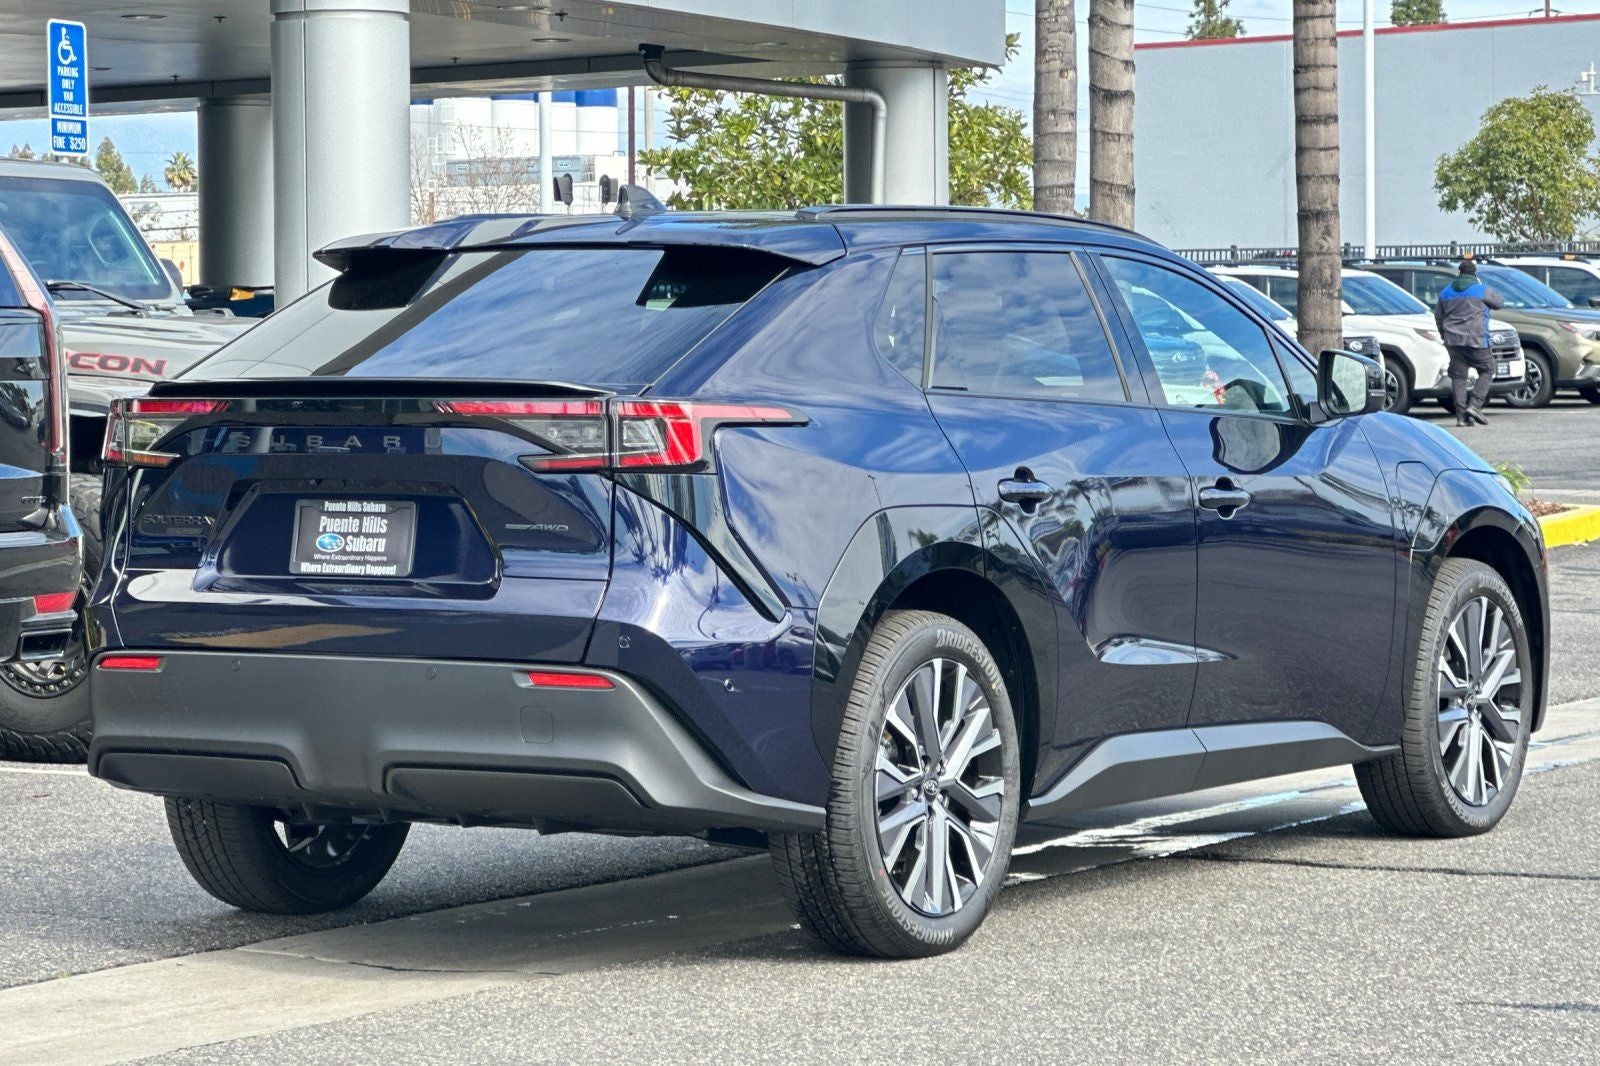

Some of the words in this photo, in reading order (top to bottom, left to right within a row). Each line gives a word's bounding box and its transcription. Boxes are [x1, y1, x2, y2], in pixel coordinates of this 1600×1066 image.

[57, 65, 79, 78] PARKING
[61, 79, 75, 90] ONLY
[63, 91, 74, 102] VAN
[53, 102, 84, 115] ACCESSIBLE
[56, 121, 82, 134] MINIMUM
[53, 137, 66, 149] FINE
[69, 136, 86, 151] $250
[236, 433, 443, 449] SUBARU
[324, 501, 347, 512] Puente
[347, 501, 362, 512] Hills
[362, 502, 387, 513] Subaru
[319, 515, 360, 533] Puente
[361, 515, 388, 534] Hills
[345, 535, 386, 552] Subaru
[331, 554, 364, 562] Extraordinary
[301, 562, 322, 573] Where
[322, 562, 365, 575] Extraordinary
[366, 564, 396, 575] Happens!
[936, 628, 1005, 697] BRIDGESTONE
